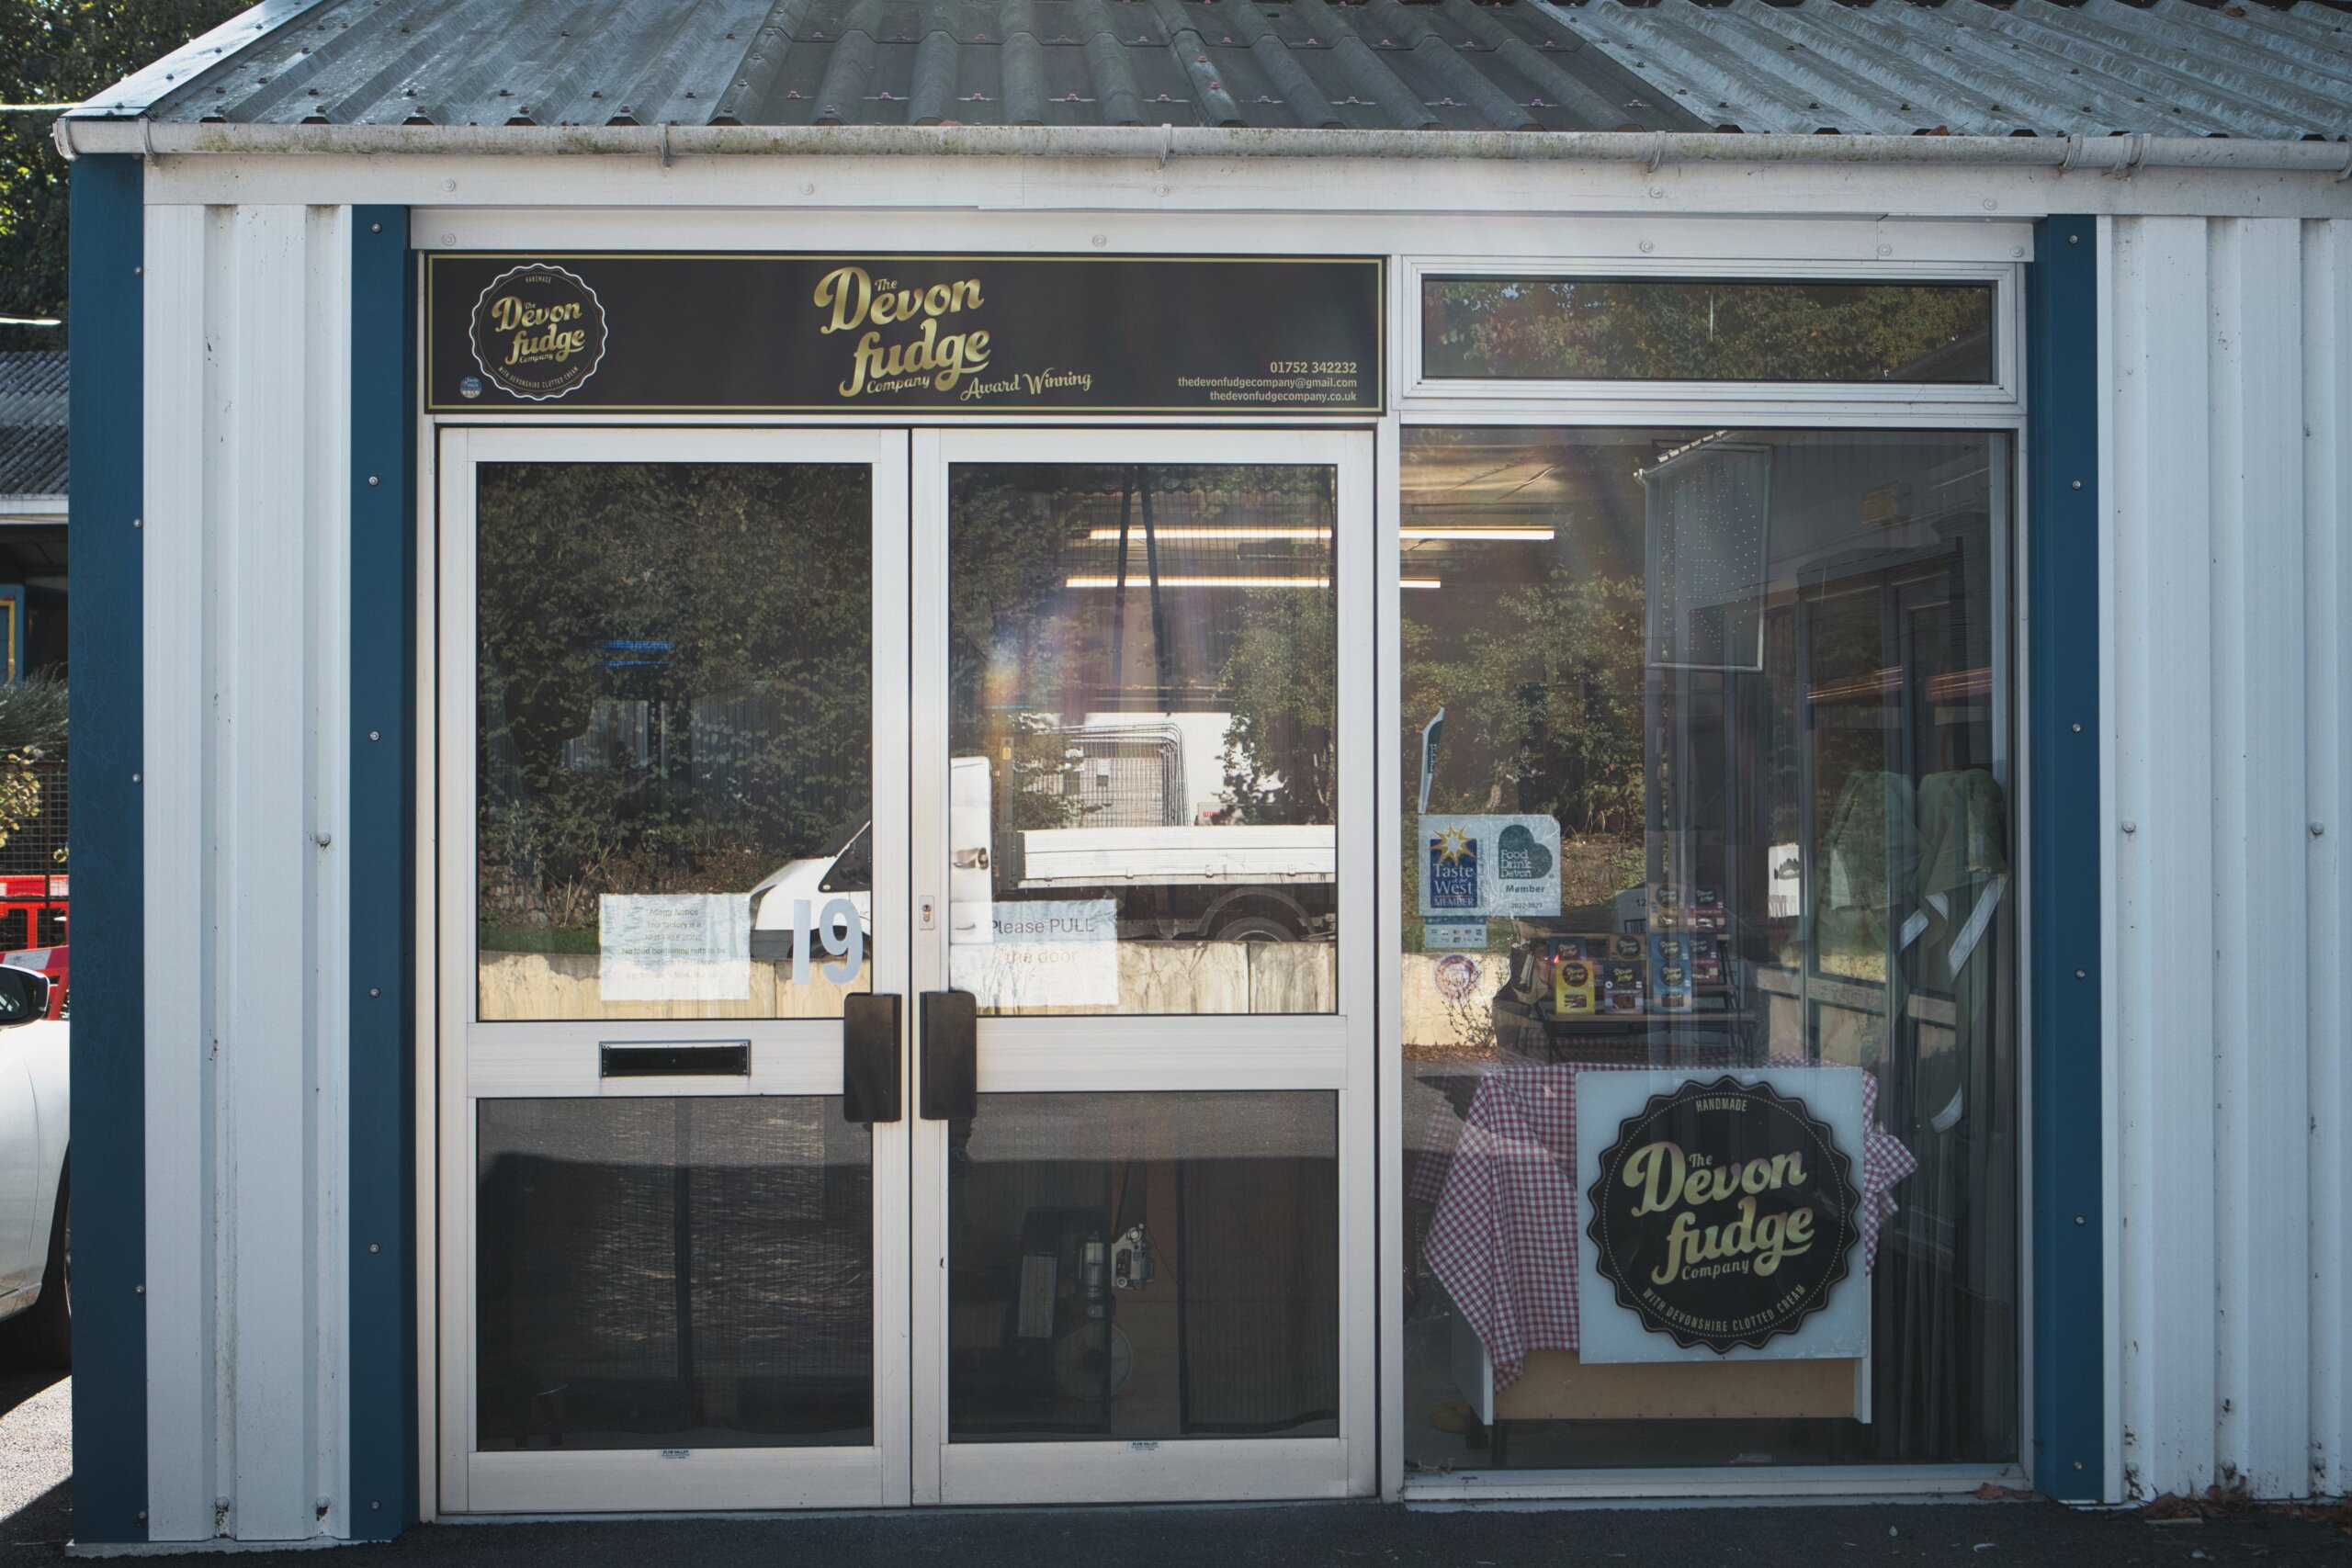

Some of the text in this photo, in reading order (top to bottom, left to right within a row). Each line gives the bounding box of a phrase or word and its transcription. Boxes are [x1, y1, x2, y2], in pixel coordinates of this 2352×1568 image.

[875, 278, 898, 291] The
[813, 266, 985, 334] Devon
[492, 296, 582, 333] Devon
[504, 323, 586, 366] fudge
[519, 354, 553, 364] Company
[839, 318, 991, 397] fudge
[1270, 362, 1357, 373] 01752 342232
[509, 373, 540, 389] DEVONSHIRE
[542, 377, 564, 388] CLOTTED
[564, 366, 579, 380] CREAM
[866, 375, 931, 394] Company
[960, 367, 1092, 400] Award Winning
[1178, 377, 1357, 389] thedevonfudgecompany@gmail.com
[1210, 390, 1356, 402] thedevonfudgecompany.co.uk
[1500, 849, 1529, 859] Food
[1433, 863, 1474, 878] Taste
[1500, 860, 1532, 869] Drink
[1500, 869, 1532, 878] Devon
[1433, 880, 1474, 895] West
[1434, 898, 1474, 907] MEMBER
[1635, 898, 1646, 907] 12
[649, 908, 673, 917] Allergy
[662, 921, 687, 930] factory
[991, 918, 1095, 934] Please PULL
[683, 933, 703, 942] ZONE
[792, 898, 864, 985] 19
[634, 947, 650, 955] food
[652, 947, 689, 957] containing
[691, 947, 707, 955] nuts
[1037, 948, 1079, 964] door
[1696, 1098, 1747, 1113] HANDMADE
[1689, 1153, 1713, 1168] The
[1622, 1141, 1808, 1218] Devon
[1651, 1195, 1815, 1285] fudge
[1681, 1259, 1749, 1280] Company
[1643, 1284, 1806, 1332] WITH DEVONSHIRE CLOTTED CREAM
